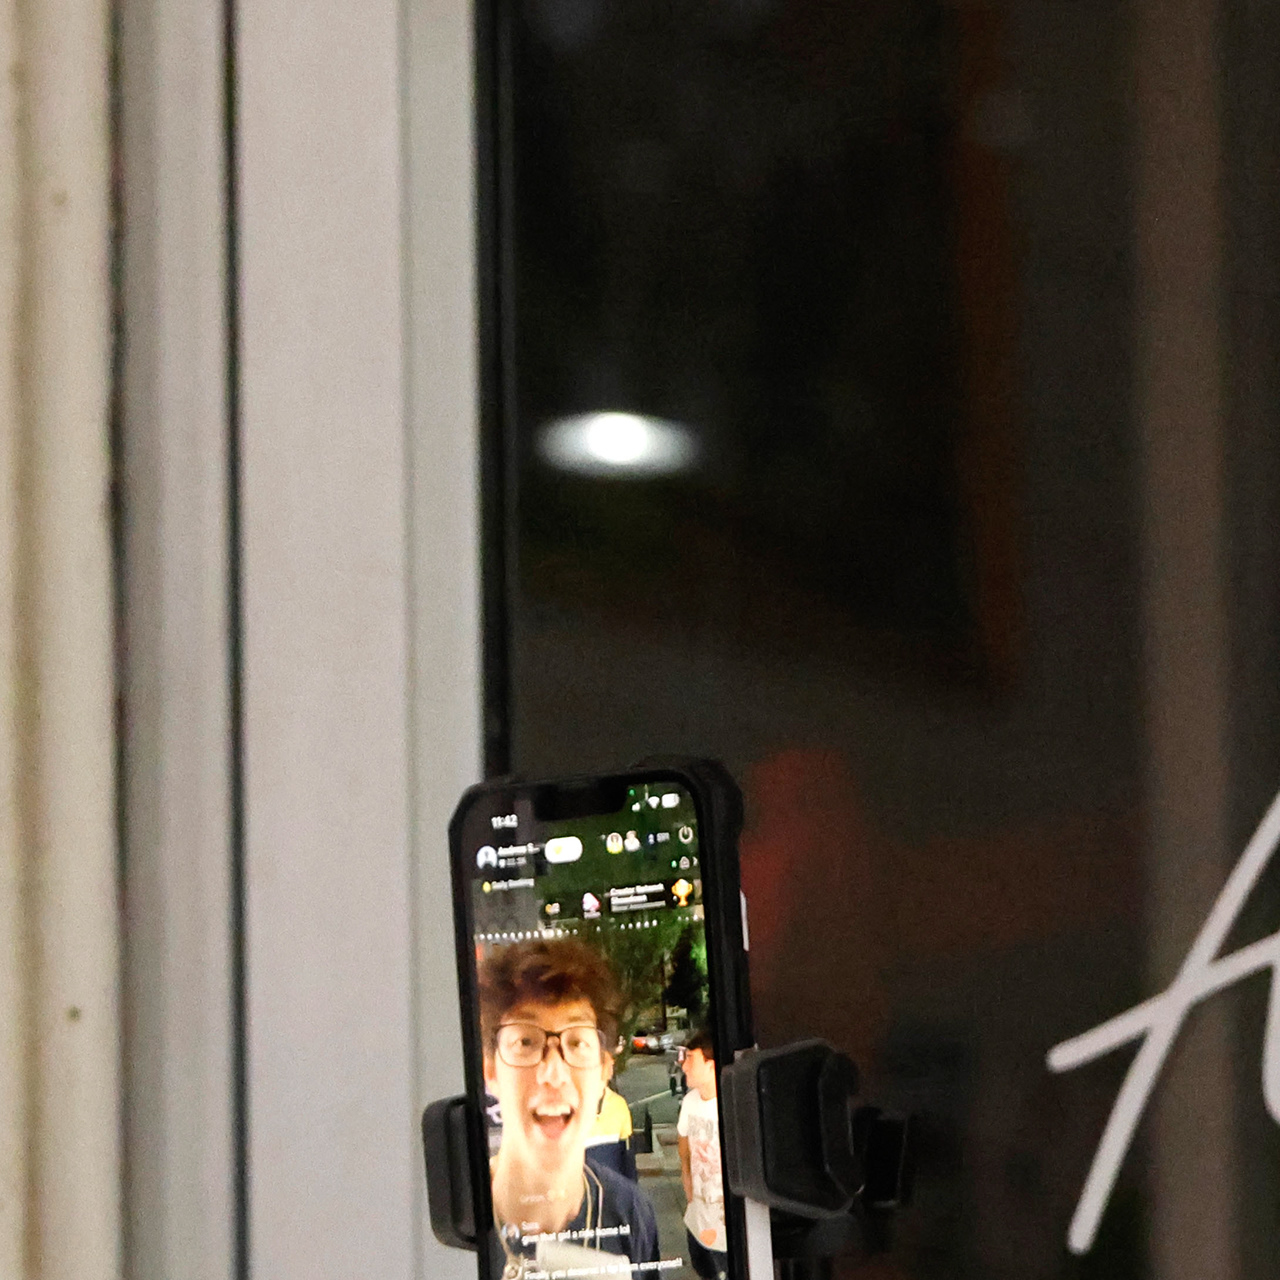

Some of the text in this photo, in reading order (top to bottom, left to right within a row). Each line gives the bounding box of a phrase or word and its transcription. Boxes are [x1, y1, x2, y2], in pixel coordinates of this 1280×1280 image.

[491, 814, 518, 829] 11:42
[596, 1226, 619, 1236] home
[619, 1224, 631, 1234] lol
